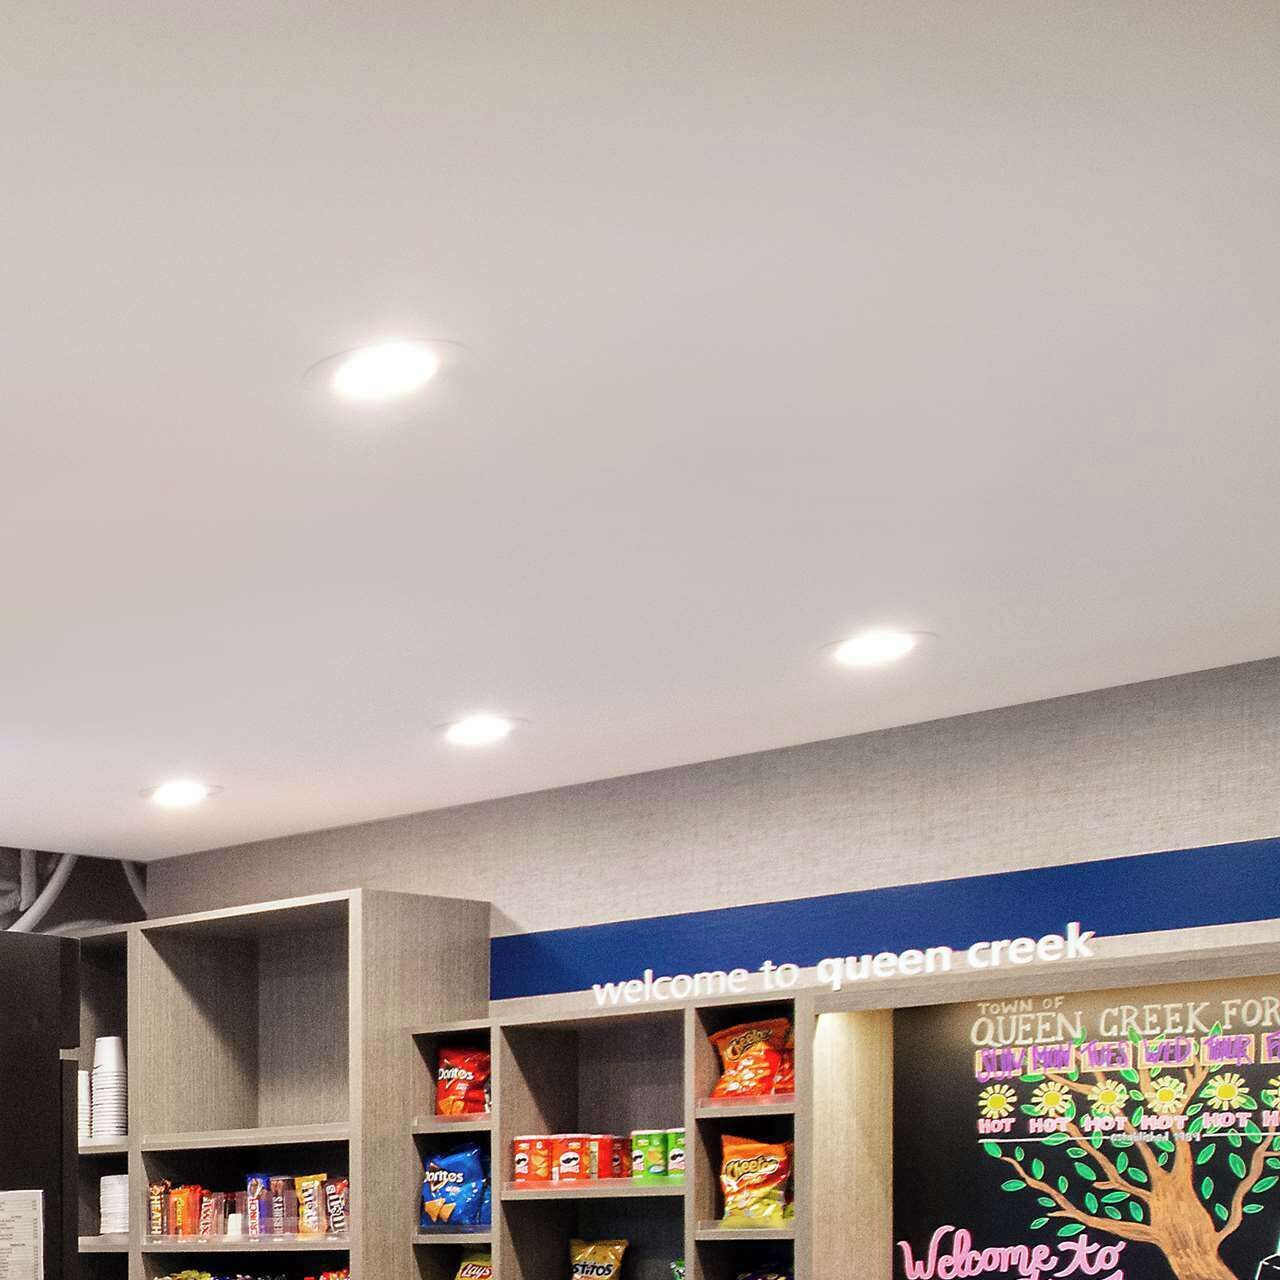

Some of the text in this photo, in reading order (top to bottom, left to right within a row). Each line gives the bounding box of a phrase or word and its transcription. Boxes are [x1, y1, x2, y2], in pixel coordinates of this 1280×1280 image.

[593, 922, 1095, 1006] welcome to queen creek
[970, 1011, 1082, 1047] QUEEN
[1100, 1002, 1210, 1036] CREEK
[978, 996, 1065, 1015] TOWN OF
[978, 1117, 1016, 1133] HOT
[1029, 1116, 1071, 1133] HOT
[1085, 1115, 1128, 1132] HOT
[1140, 1114, 1189, 1131] HOT
[1203, 1111, 1253, 1129] HOT
[150, 1195, 162, 1235] HEATH
[898, 1225, 1126, 1280] Welcome to
